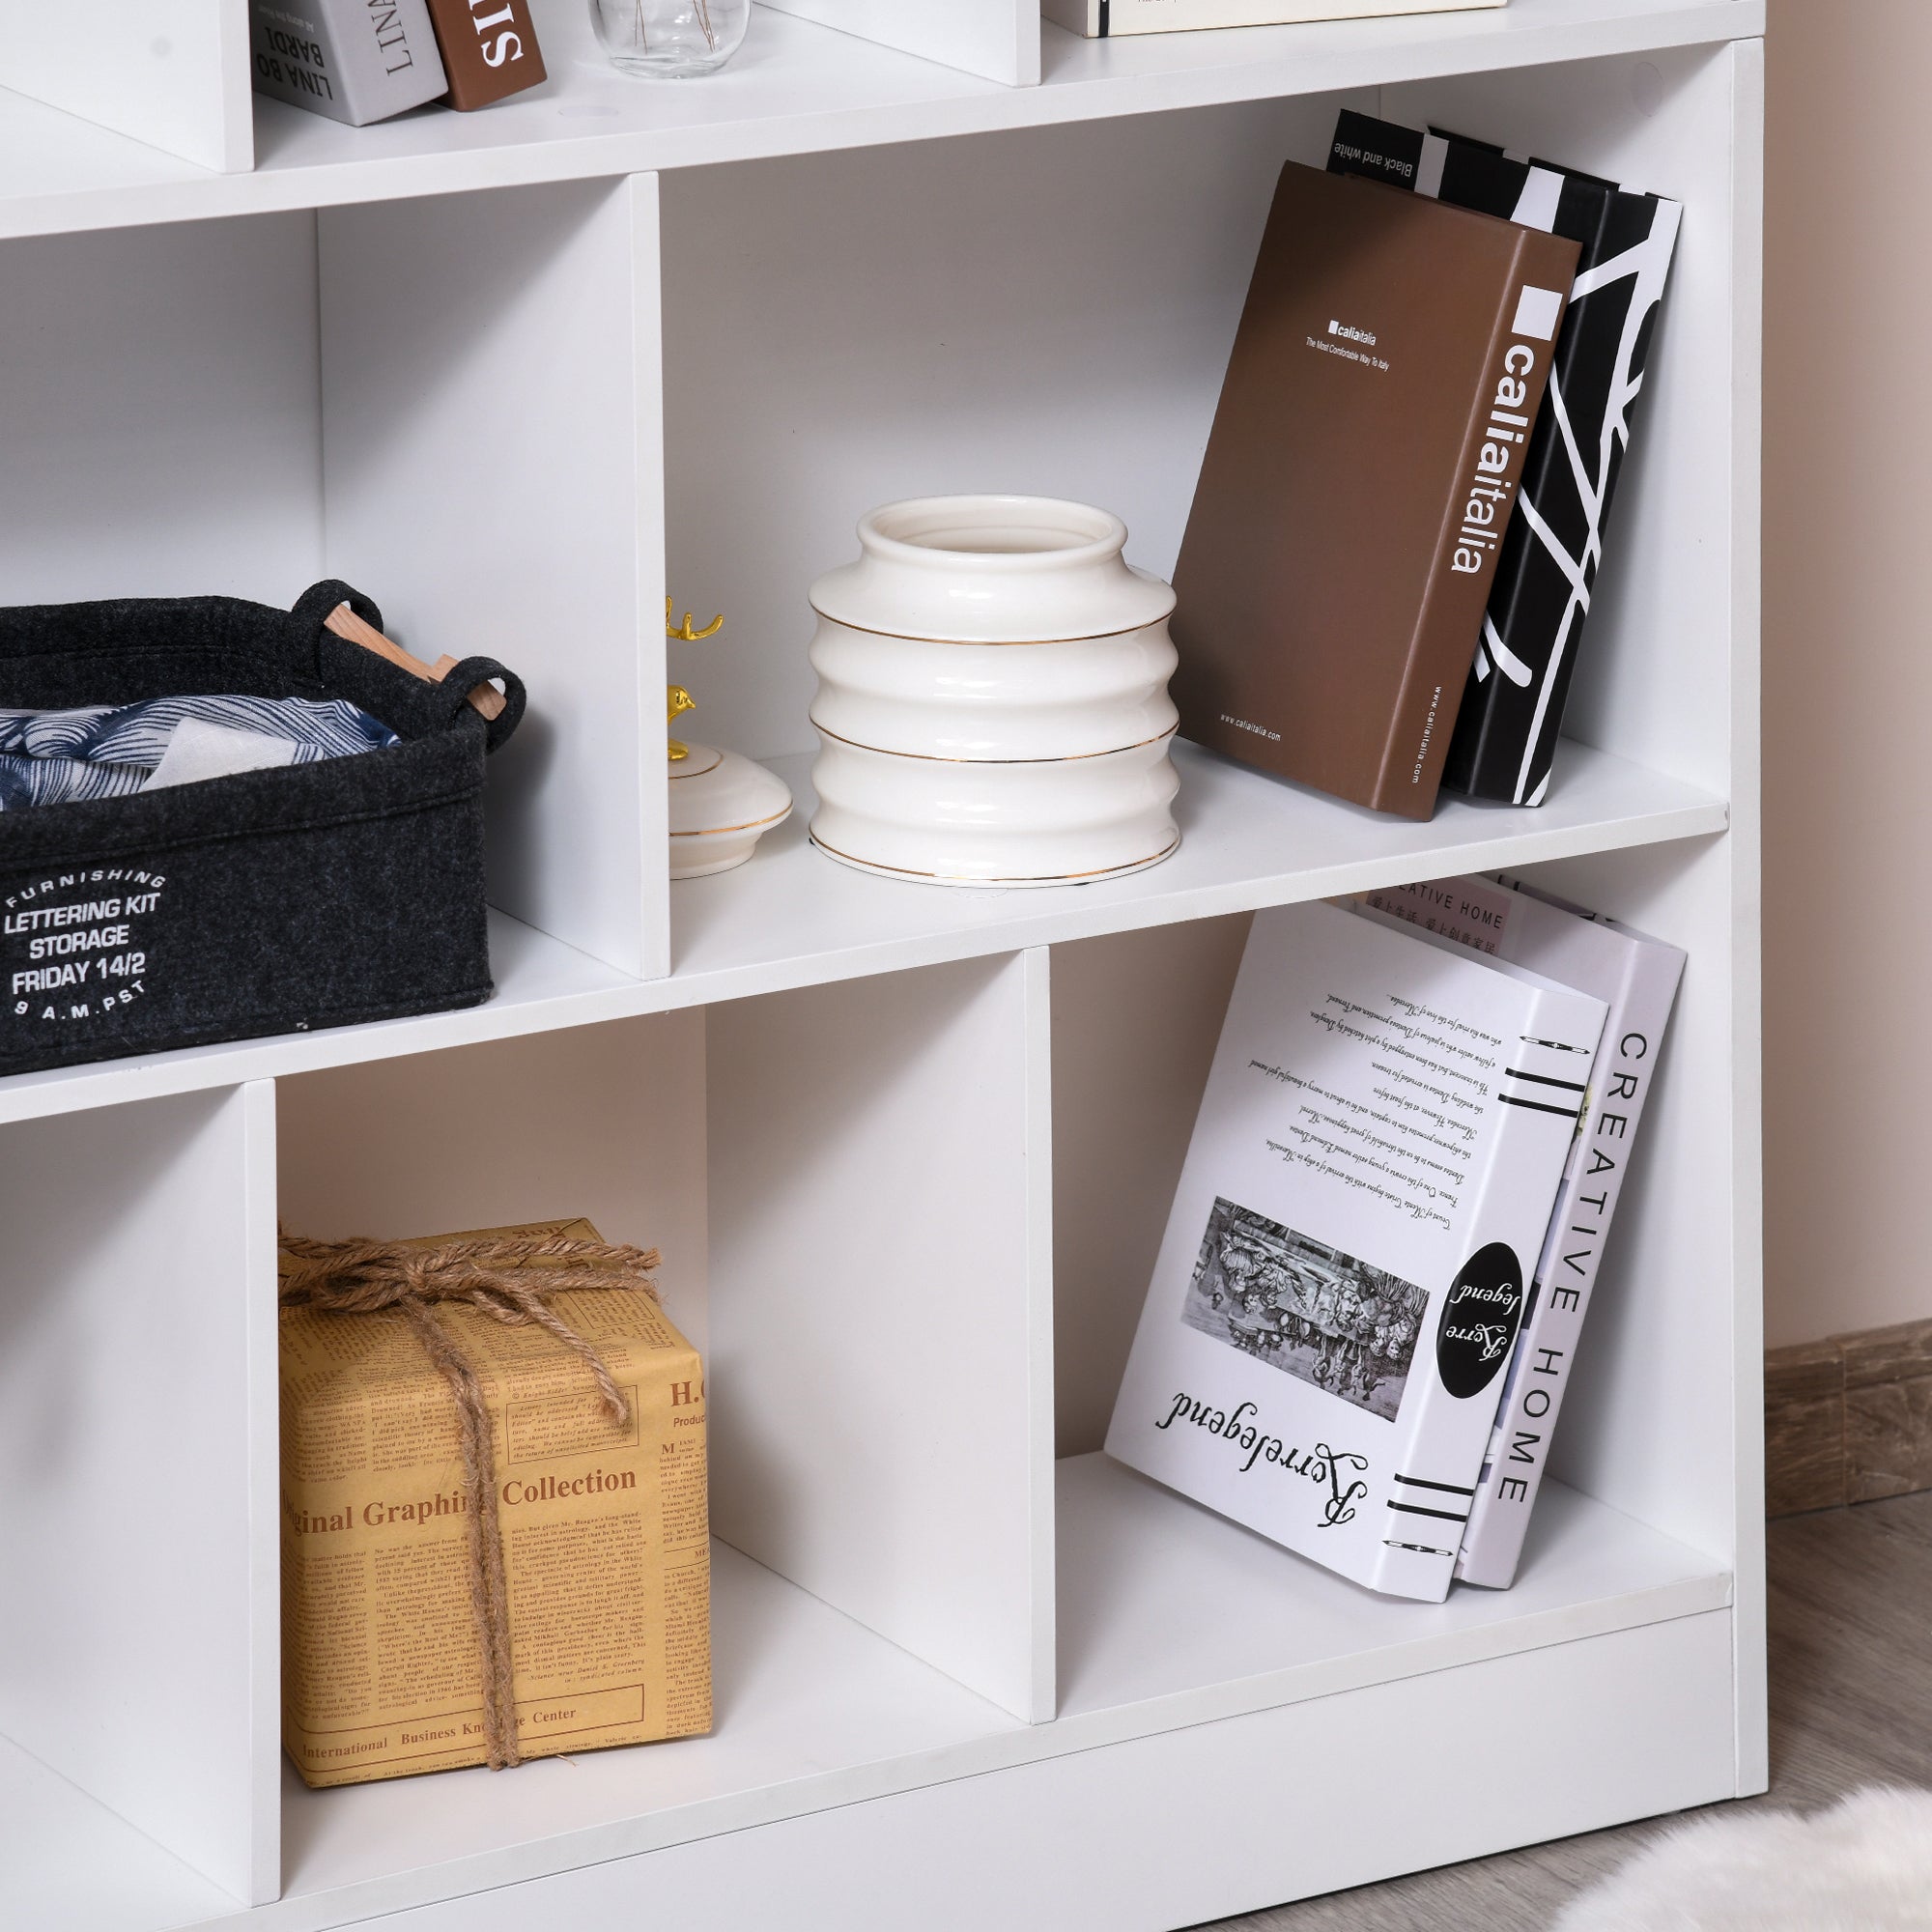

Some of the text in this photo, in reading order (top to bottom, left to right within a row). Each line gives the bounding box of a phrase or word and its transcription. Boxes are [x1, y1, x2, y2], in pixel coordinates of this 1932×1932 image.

[265, 26, 325, 69] BARDI
[256, 53, 332, 100] LINA BO
[1334, 143, 1412, 177] Black and white
[1306, 336, 1317, 348] The
[1317, 340, 1329, 352] Most
[1329, 345, 1359, 361] Comfortable
[1359, 354, 1372, 366] Way
[1338, 327, 1376, 346] caliaitalia
[1451, 345, 1535, 574] caliaitalia
[1412, 686, 1442, 783] www.caliaitalia.com
[6, 869, 166, 908] FURNISHING
[4, 893, 160, 934] LETTERING KIT
[1460, 901, 1503, 928] HOME
[29, 924, 129, 959] STORAGE
[12, 952, 145, 994] FRIDAY 14/2
[14, 1001, 28, 1014] 9
[1497, 1033, 1647, 1503] CREATIVE HOME
[1449, 1283, 1520, 1316] legend
[669, 1381, 704, 1406] H.
[502, 1469, 637, 1505] Collection
[302, 1738, 387, 1758] International
[401, 1725, 455, 1745] Business
[533, 1708, 577, 1724] Center
